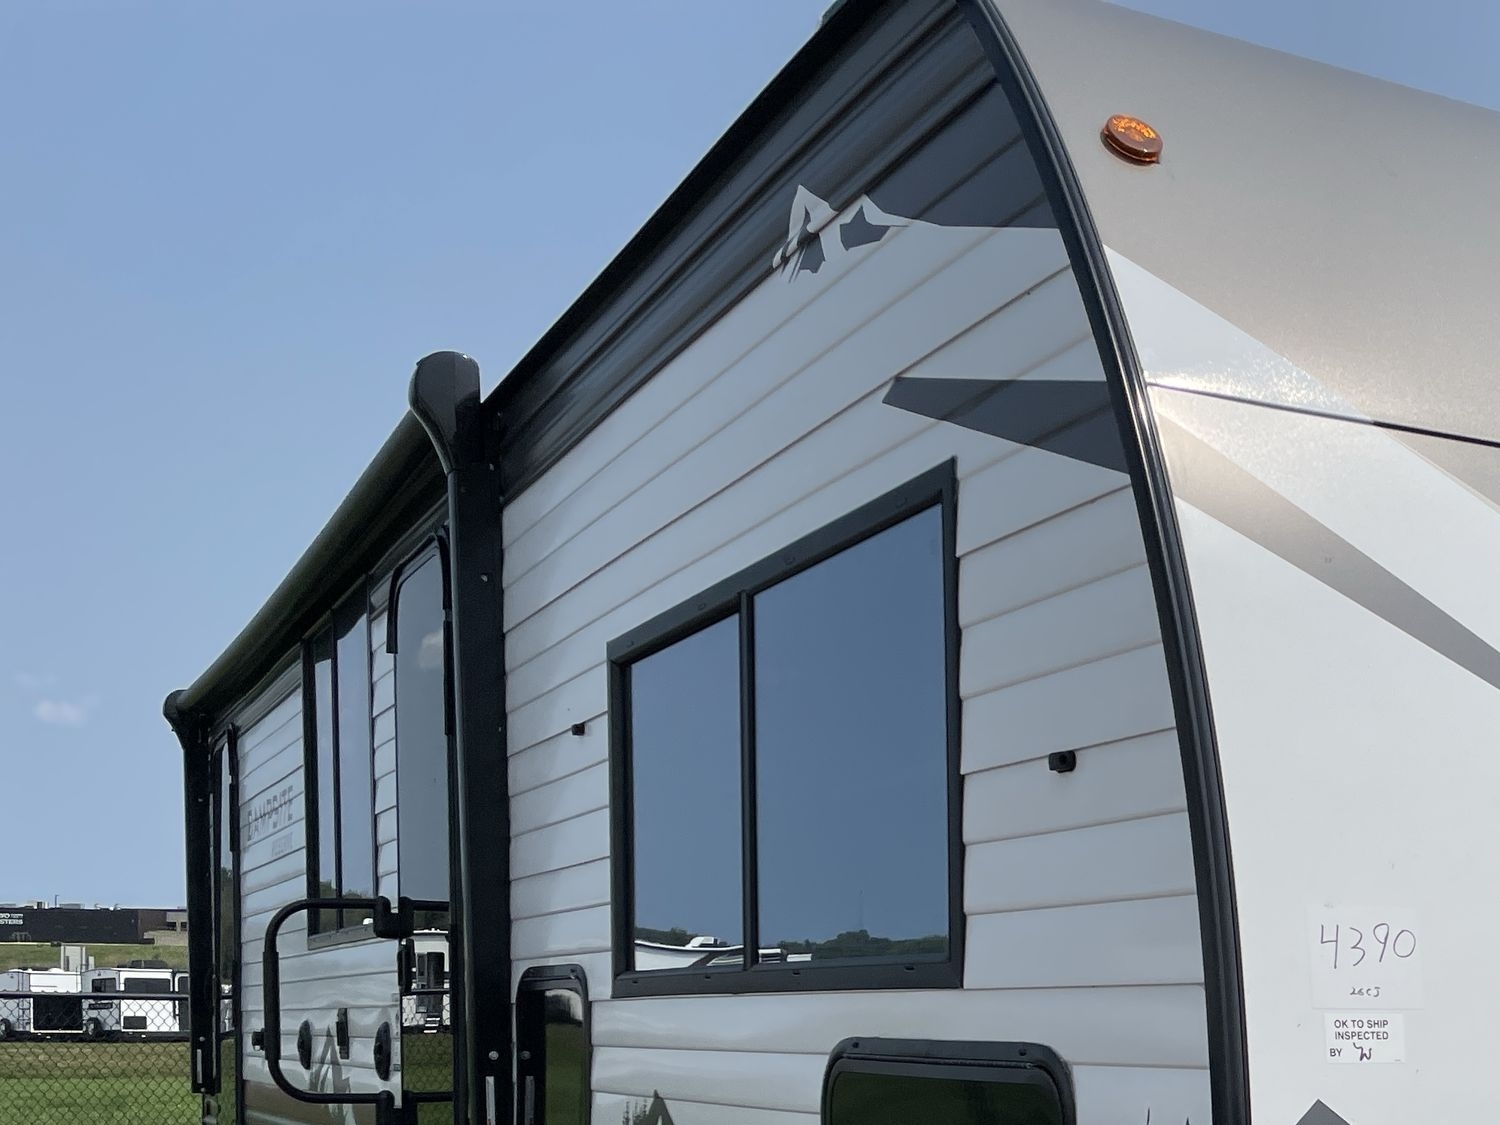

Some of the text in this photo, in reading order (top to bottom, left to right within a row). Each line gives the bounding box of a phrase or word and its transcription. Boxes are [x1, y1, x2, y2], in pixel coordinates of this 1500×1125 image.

[1320, 922, 1417, 970] 4390
[1333, 1019, 1389, 1029] OK TO SHIP
[1334, 1031, 1389, 1041] INSPECTED
[1329, 1048, 1343, 1057] BY
